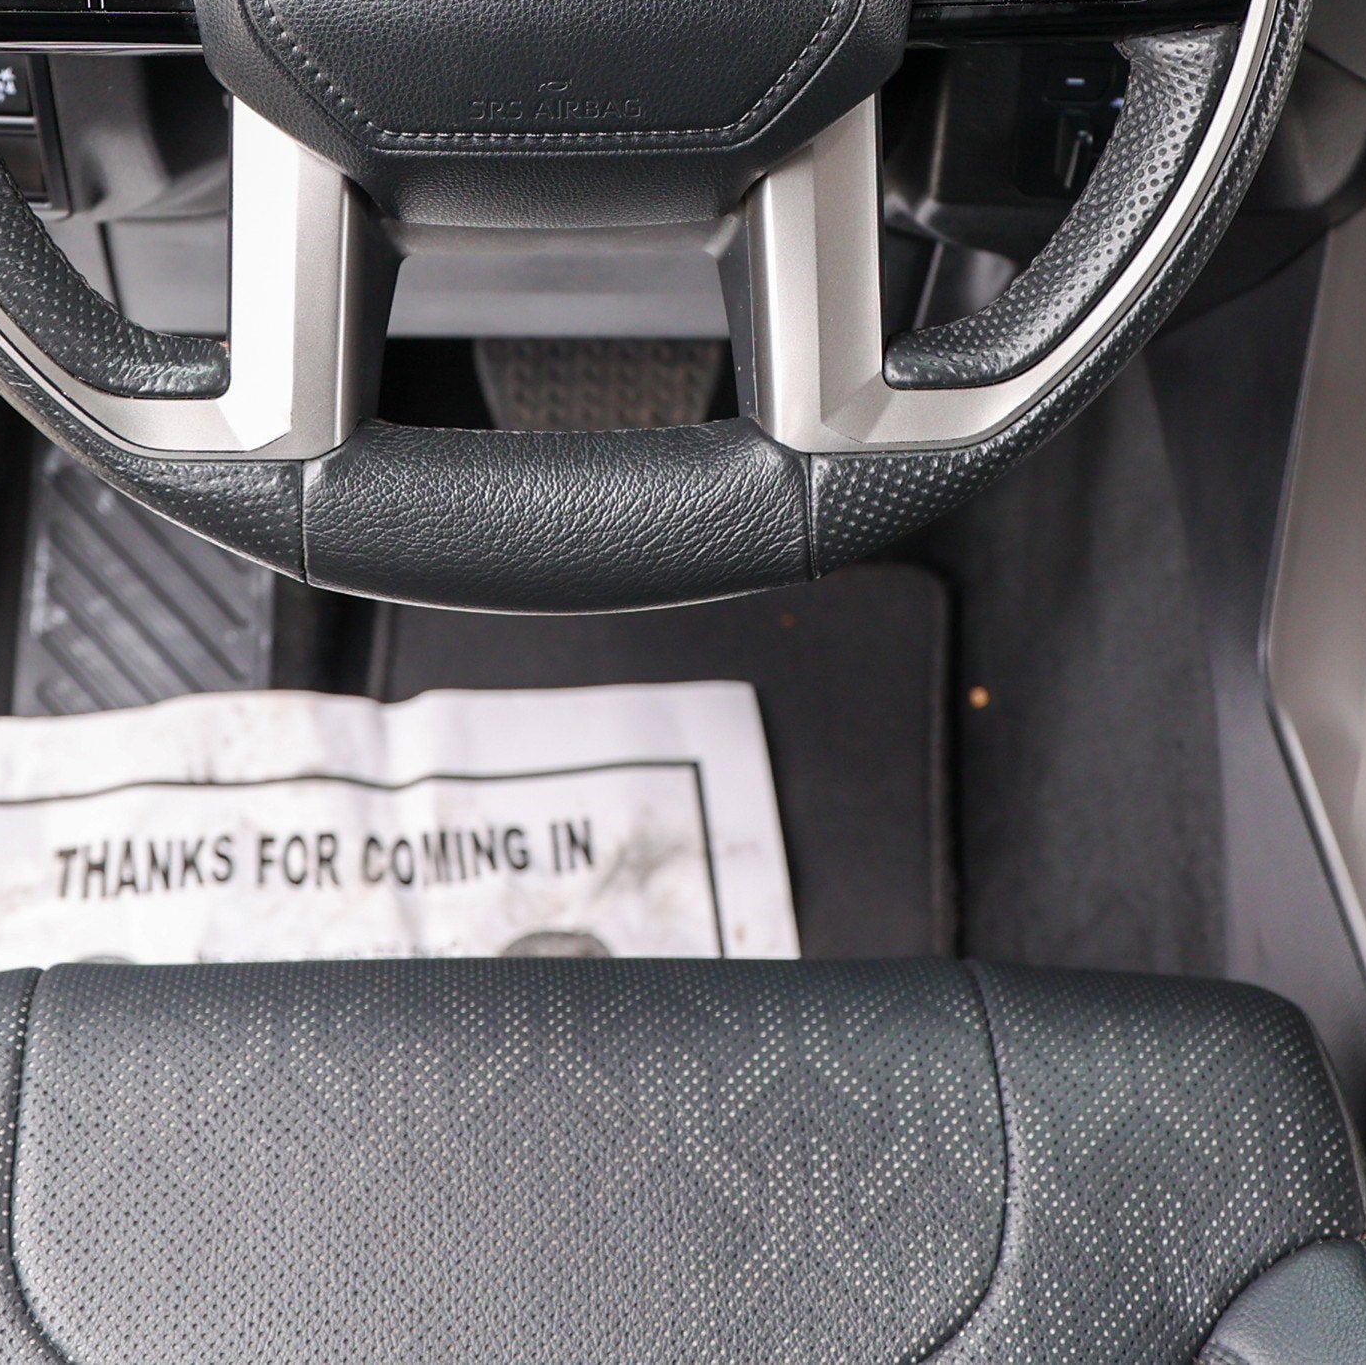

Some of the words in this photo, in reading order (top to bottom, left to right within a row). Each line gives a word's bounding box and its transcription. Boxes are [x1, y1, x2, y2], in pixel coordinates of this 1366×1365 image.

[469, 100, 524, 120] SRS
[535, 99, 642, 120] AIRBAG
[54, 833, 235, 900] THANKS
[257, 830, 338, 890] FOR
[362, 821, 529, 888] COMING
[552, 817, 595, 872] IN
